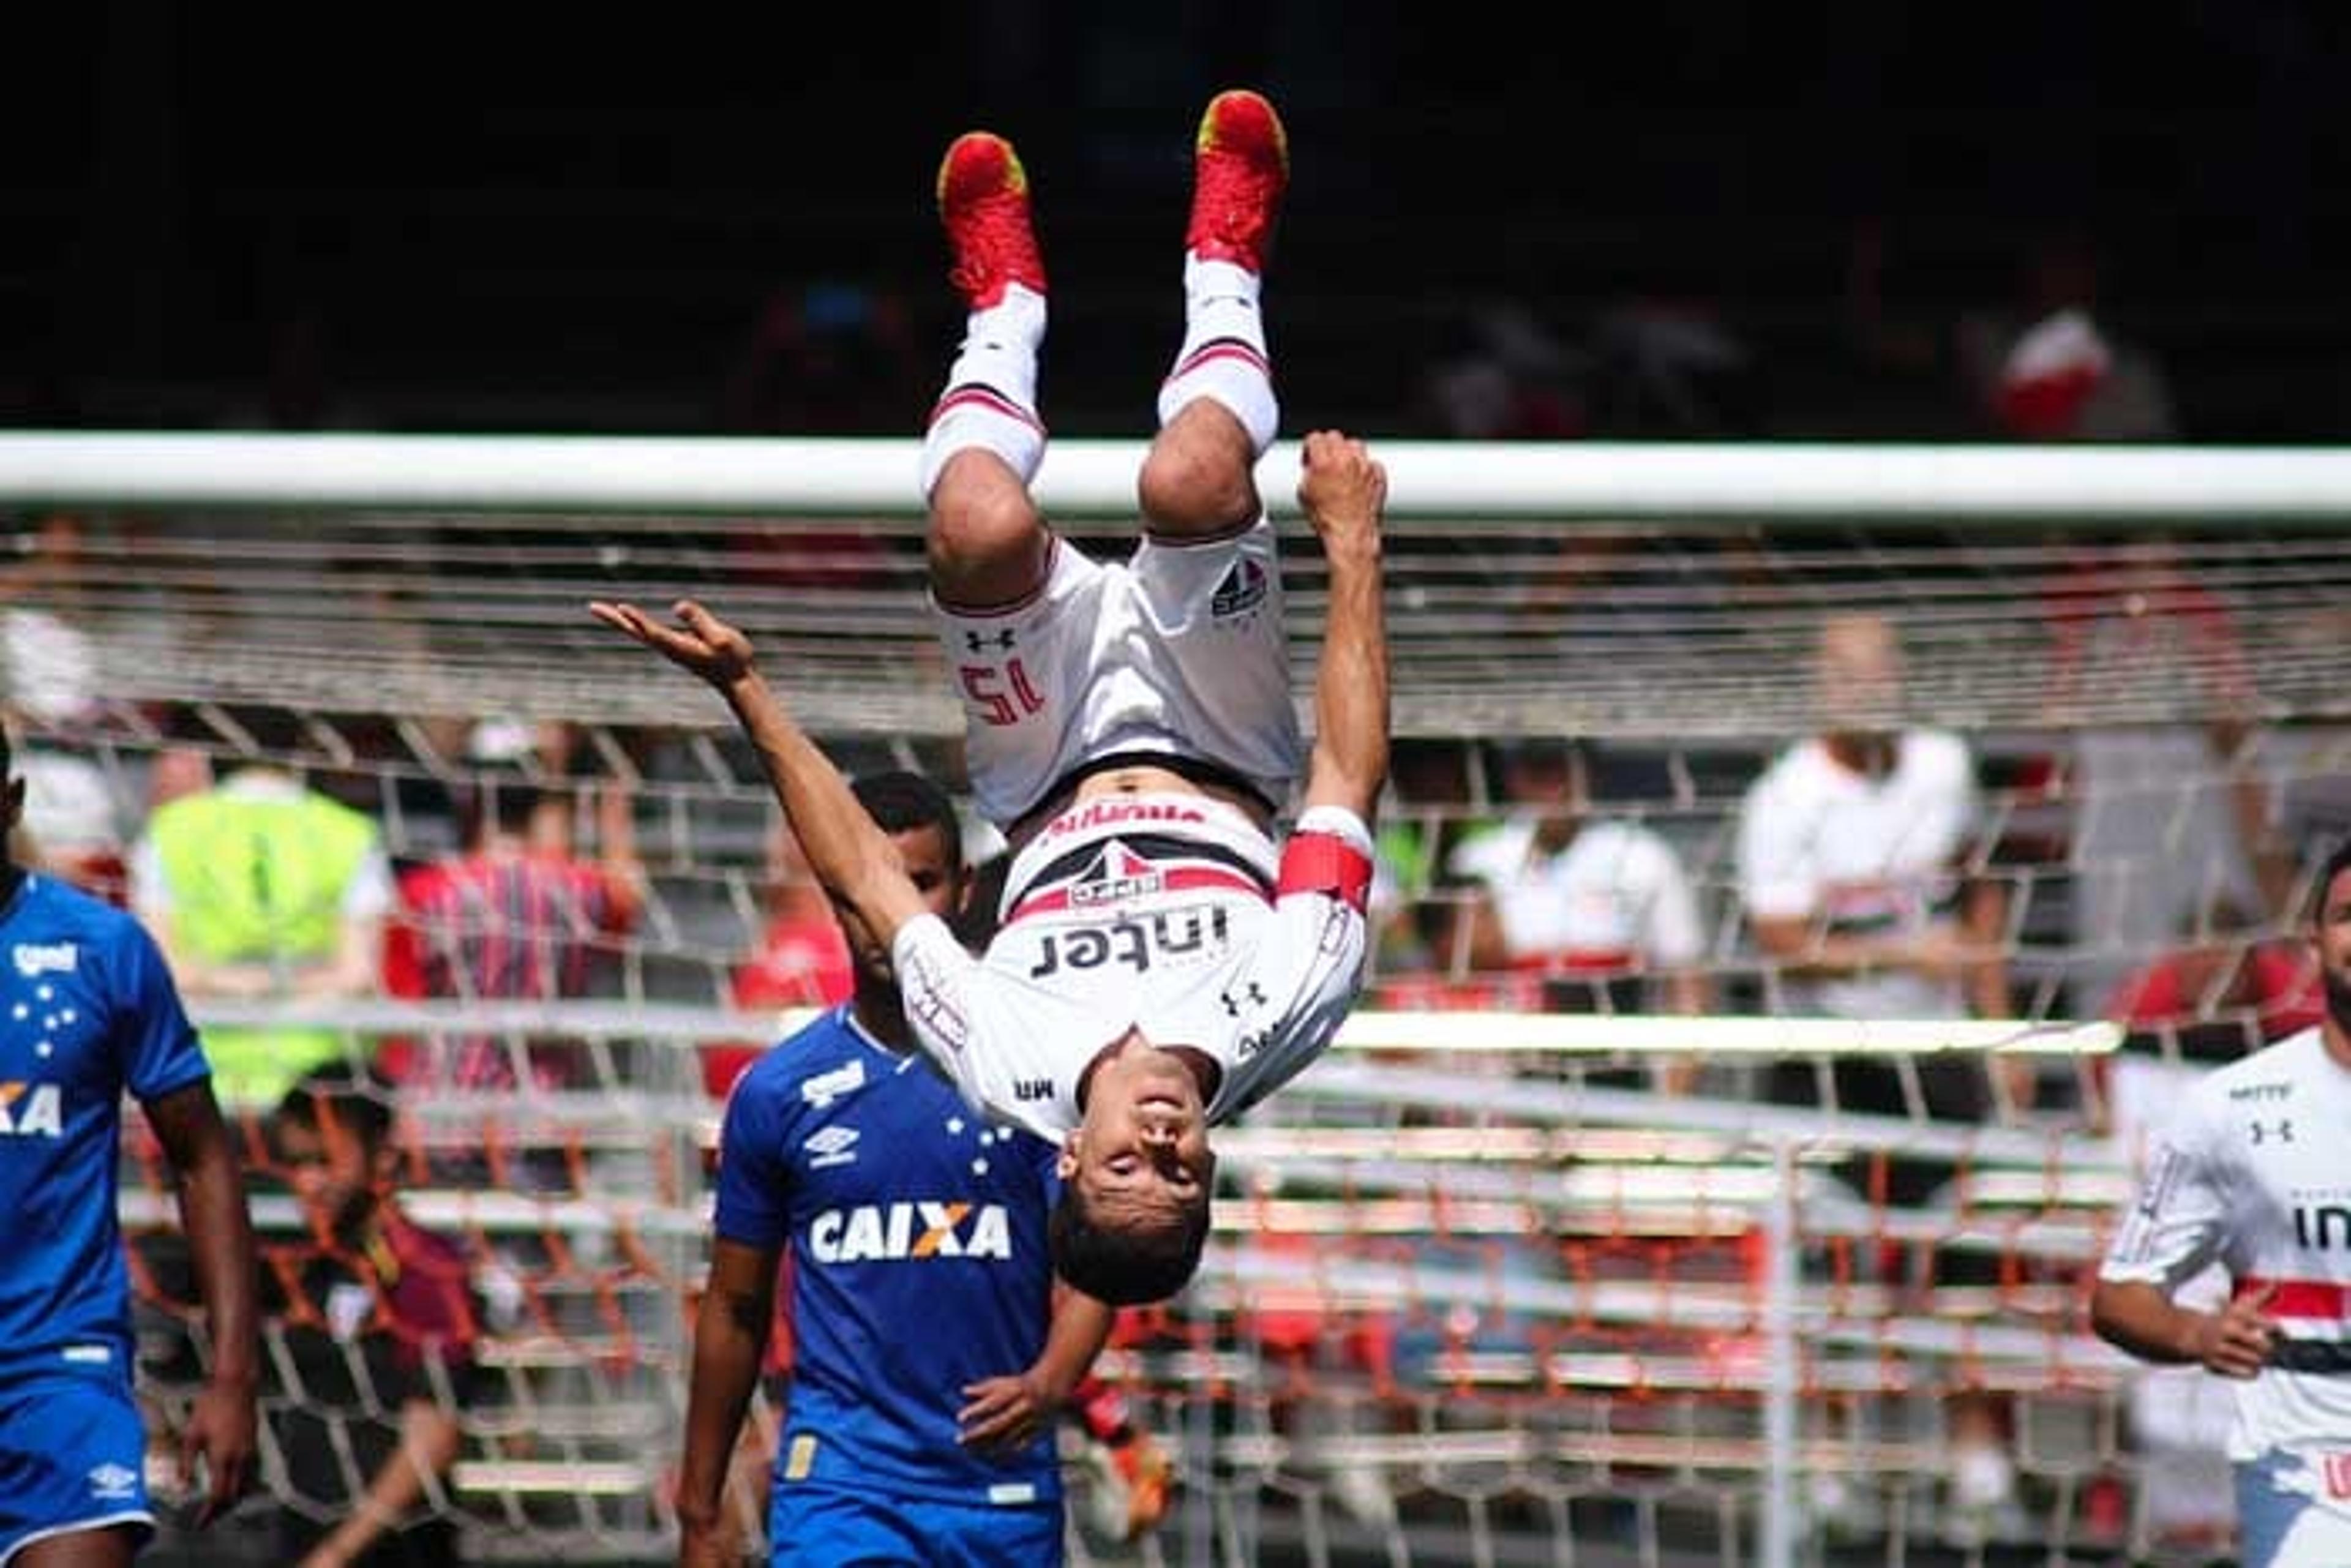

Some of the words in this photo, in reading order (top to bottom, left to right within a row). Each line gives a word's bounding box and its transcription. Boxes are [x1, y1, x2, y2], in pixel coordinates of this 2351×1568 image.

[960, 657, 1044, 726] 15
[1030, 904, 1228, 978] inter
[810, 1201, 1011, 1262] CAIXA
